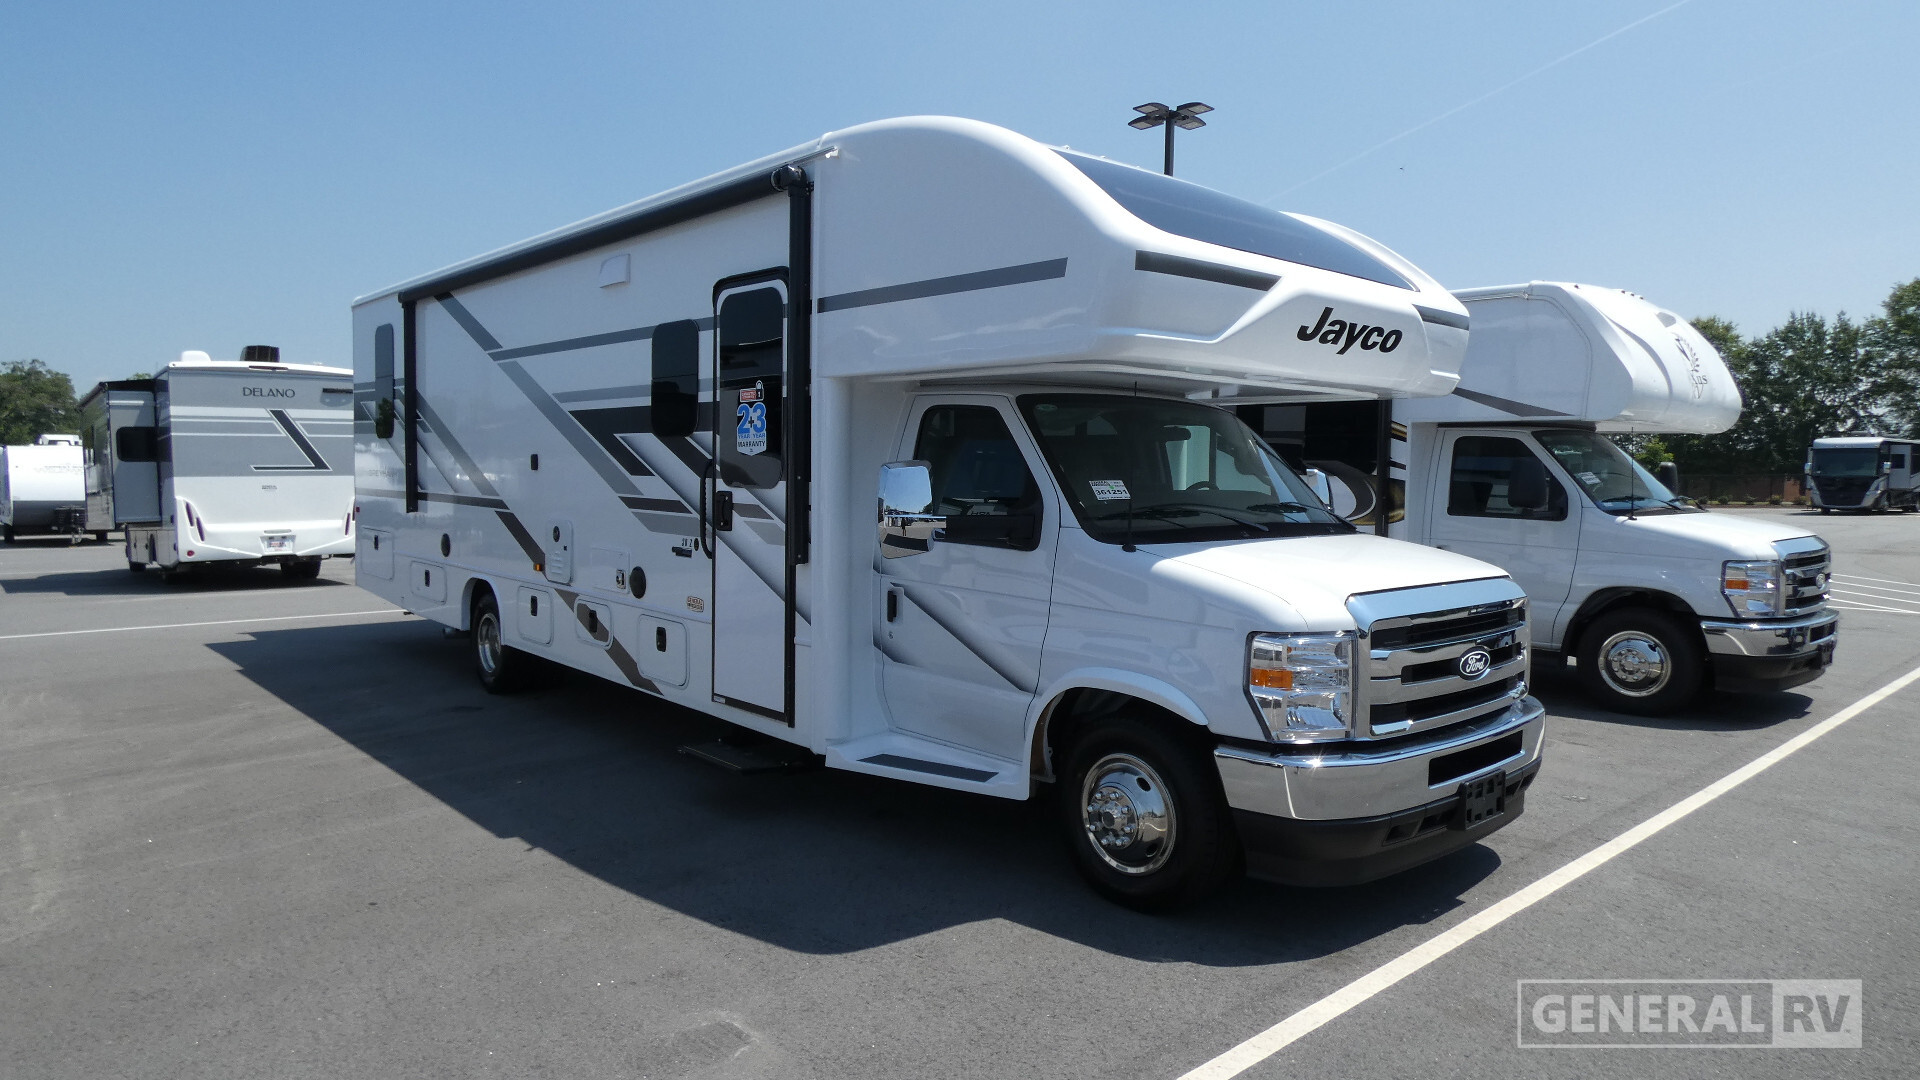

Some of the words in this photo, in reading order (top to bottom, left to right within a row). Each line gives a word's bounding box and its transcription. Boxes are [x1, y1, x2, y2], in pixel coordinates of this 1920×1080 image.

[1297, 306, 1403, 355] Jayco
[242, 386, 296, 398] DELANO
[738, 440, 765, 448] WARRANTY
[1466, 655, 1485, 672] Ford
